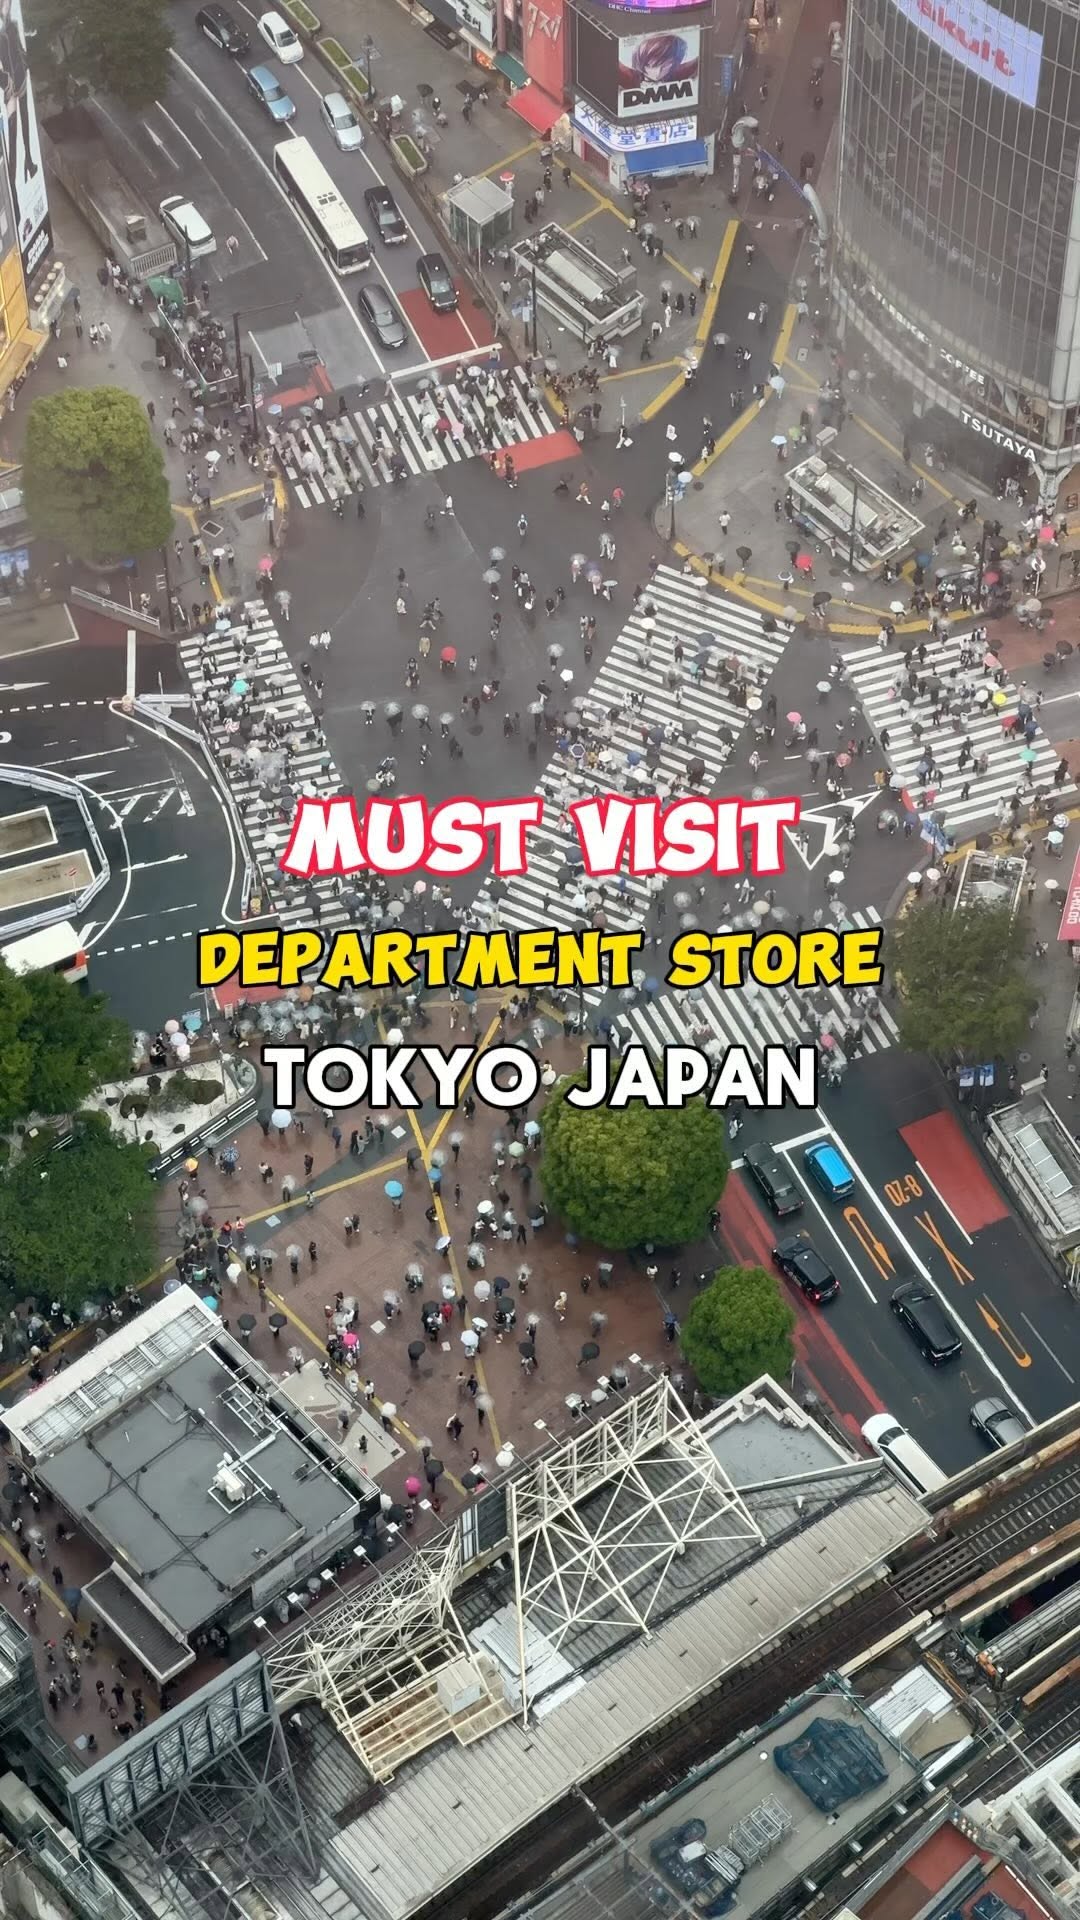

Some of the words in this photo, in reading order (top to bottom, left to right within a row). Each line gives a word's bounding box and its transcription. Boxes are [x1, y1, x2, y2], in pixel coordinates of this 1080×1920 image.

[623, 80, 694, 108] DMM
[960, 410, 1037, 463] TSUTAYA
[884, 1174, 923, 1207] 8-20
